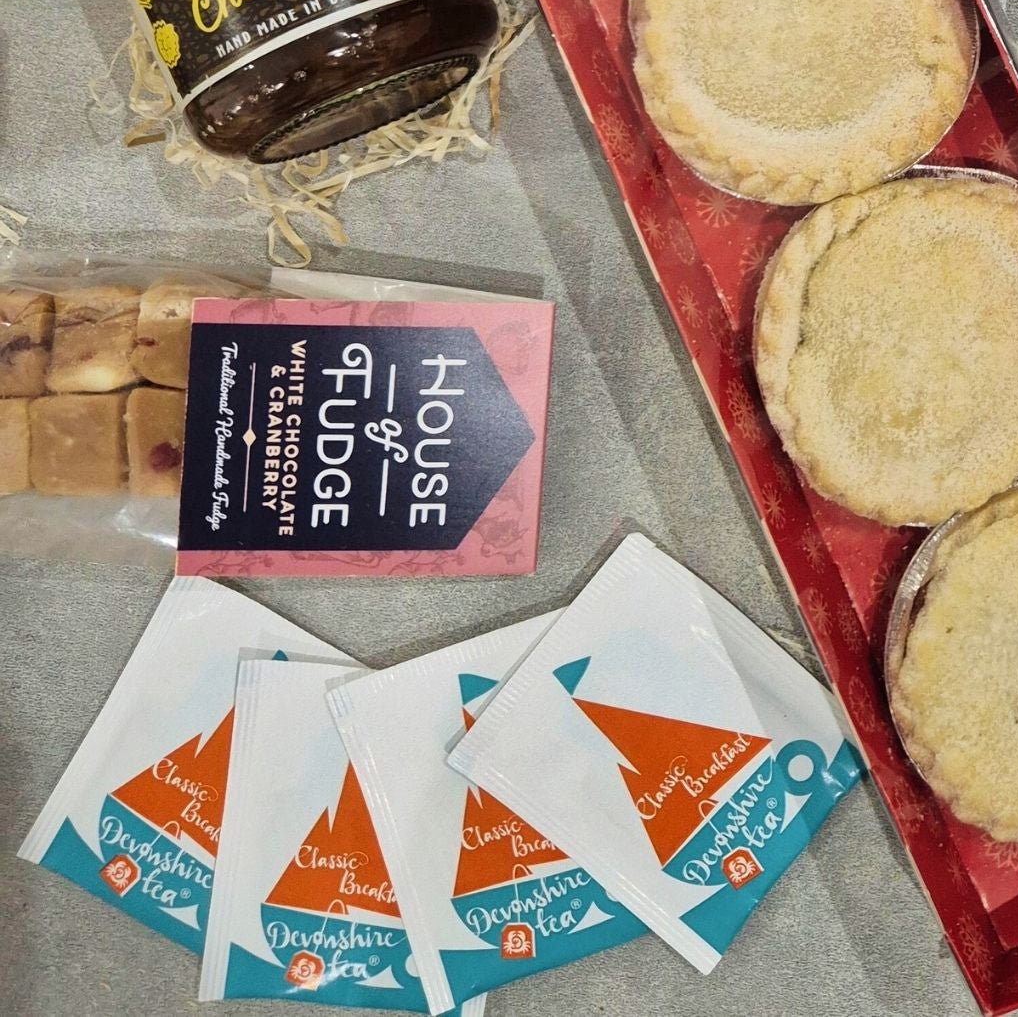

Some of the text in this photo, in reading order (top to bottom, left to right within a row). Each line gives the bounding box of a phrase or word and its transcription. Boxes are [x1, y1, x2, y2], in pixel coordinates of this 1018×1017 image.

[216, 30, 251, 58] HAND
[257, 11, 298, 39] MADE
[304, 0, 322, 17] IN
[204, 341, 239, 532] Traditional Handmade Fudge
[261, 365, 287, 511] & CRANBERRY
[278, 338, 308, 536] WHITE CHOCOLATE
[311, 342, 373, 528] FUDGE
[364, 418, 409, 463] of
[409, 353, 468, 528] HOUSE
[152, 757, 219, 802] Classic
[635, 755, 688, 820] Classic
[682, 732, 751, 797] Breakfast
[99, 816, 212, 889] Devonshire
[180, 798, 222, 842] Break
[462, 814, 524, 850] Classic
[682, 755, 773, 885] Devonshire
[294, 845, 369, 870] Classic
[267, 921, 406, 950] Devonshire
[466, 871, 592, 936] Devonshire
